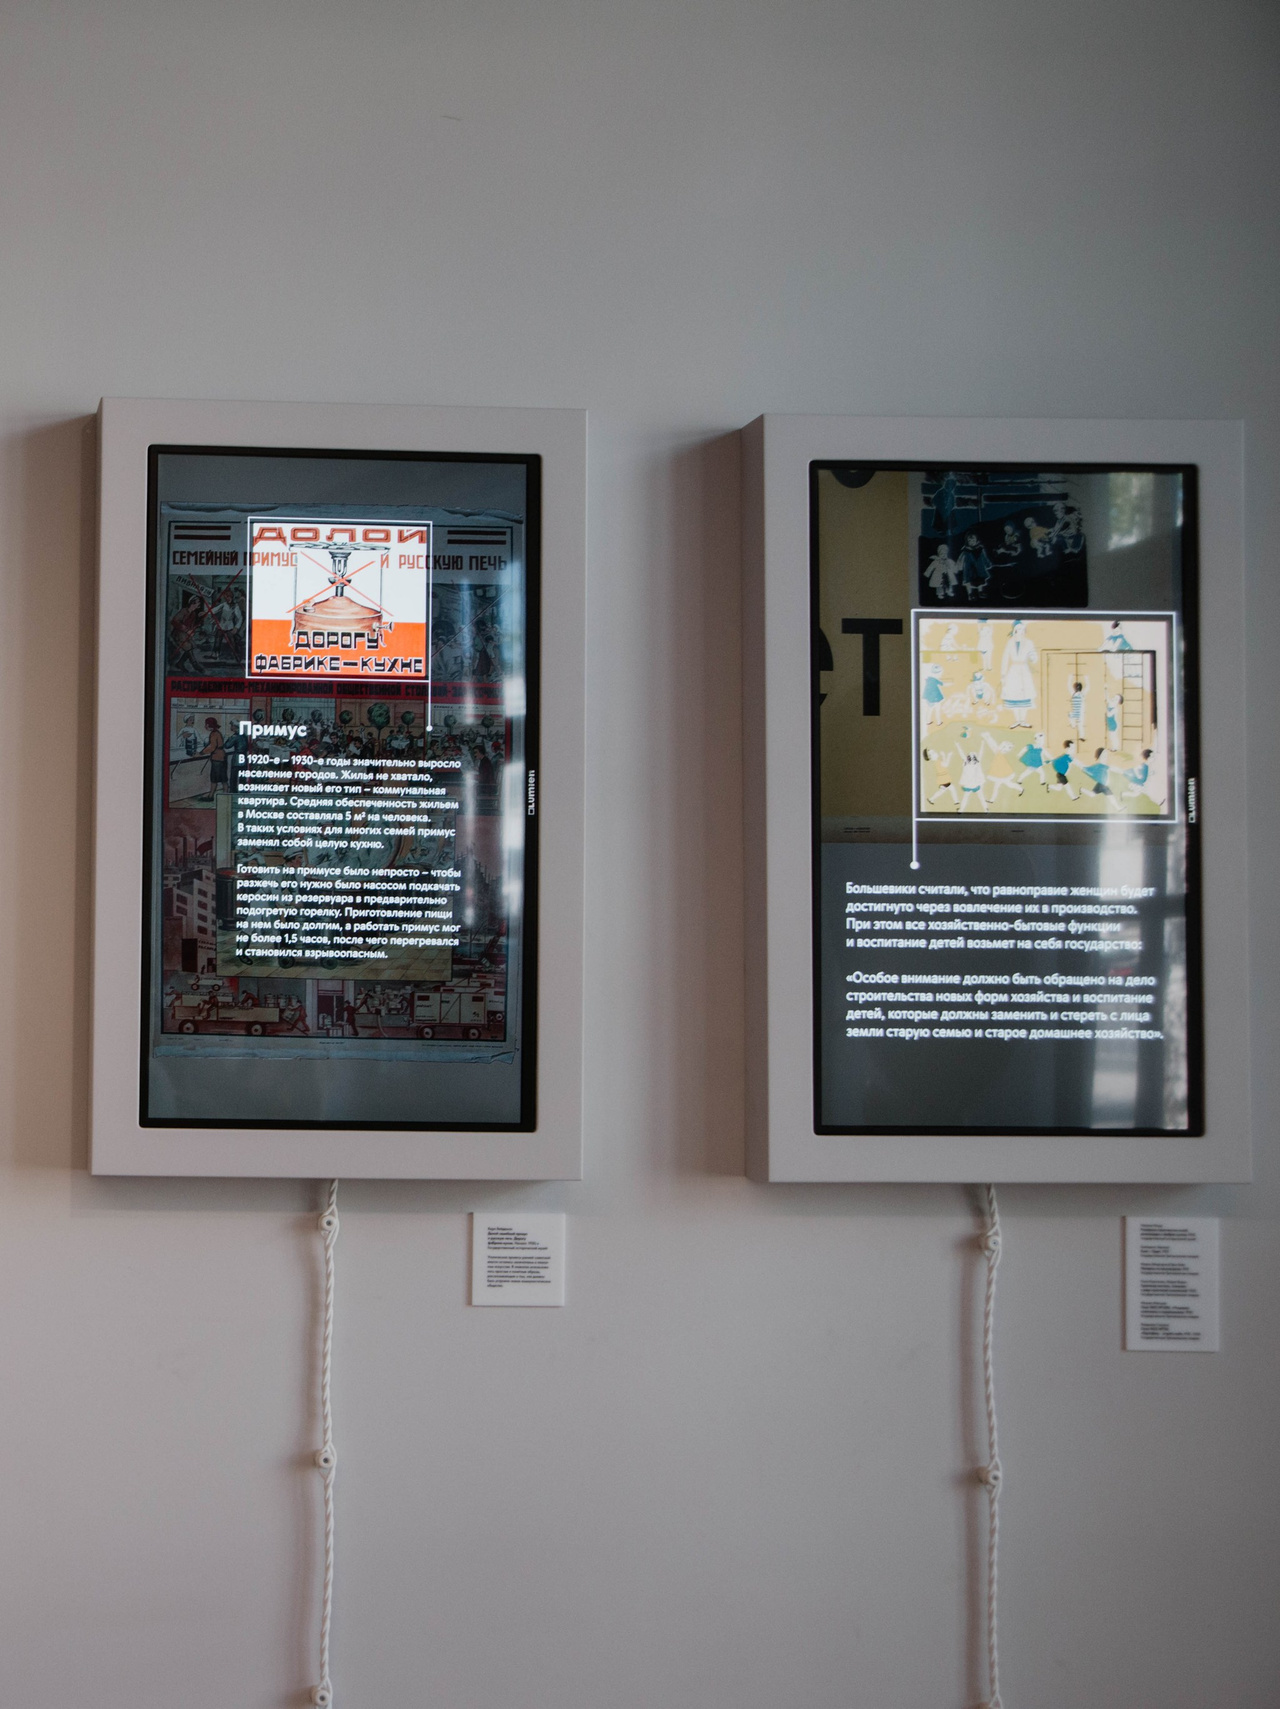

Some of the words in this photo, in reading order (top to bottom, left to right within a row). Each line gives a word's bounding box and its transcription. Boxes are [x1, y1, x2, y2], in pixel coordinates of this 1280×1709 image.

[253, 526, 426, 547] ДОЛОЙ
[172, 549, 238, 566] СЕМЕЙНЫЙ
[243, 551, 298, 567] ПРИМУС
[380, 553, 389, 569] И
[399, 553, 463, 571] РУССКУЮ
[469, 555, 508, 571] ПЕЧЬ
[295, 630, 380, 652] ДОРОГУ
[239, 721, 307, 740] Примус
[239, 754, 245, 764] В
[247, 755, 280, 765] 1920-е
[291, 755, 324, 766] 1930-е
[326, 758, 351, 768] годы
[353, 758, 416, 767] значительно
[418, 759, 461, 770] выросло
[238, 770, 292, 779] население
[295, 771, 338, 782] городов.
[341, 770, 373, 780] Жилья
[376, 772, 388, 781] не
[391, 773, 433, 783] хватало,
[238, 784, 289, 793] возникает
[291, 784, 323, 793] новый
[325, 786, 342, 794] его
[344, 786, 361, 794] тип
[373, 786, 446, 797] коммунальная
[238, 798, 287, 808] квартира.
[290, 797, 333, 809] Средняя
[335, 798, 417, 808] обеспеченность
[419, 800, 459, 809] жильем
[238, 811, 243, 819] в
[246, 810, 284, 820] Москве
[286, 812, 343, 821] составляла
[345, 811, 351, 821] 5
[368, 813, 380, 821] на
[382, 814, 431, 822] человека.
[238, 824, 244, 833] В
[246, 825, 274, 833] таких
[276, 826, 322, 836] условиях
[324, 826, 342, 836] для
[345, 827, 381, 835] многих
[384, 826, 415, 835] семей
[418, 828, 455, 838] примус
[237, 839, 279, 847] заменял
[282, 838, 313, 848] собой
[315, 840, 348, 850] целую
[350, 840, 384, 851] кухню.
[846, 883, 916, 895] Большевики
[918, 885, 968, 897] считали,
[971, 886, 991, 895] что
[993, 886, 1068, 898] равноправие
[846, 902, 914, 915] достигнуто
[916, 903, 951, 915] через
[953, 904, 1023, 914] вовлечение
[1025, 904, 1040, 914] их
[1042, 904, 1049, 914] в
[1051, 905, 1137, 917] производство.
[846, 919, 871, 933] При
[873, 921, 903, 931] этом
[905, 921, 926, 931] все
[928, 920, 1066, 932] хозяйственно-бытовые
[1068, 920, 1121, 935] функции
